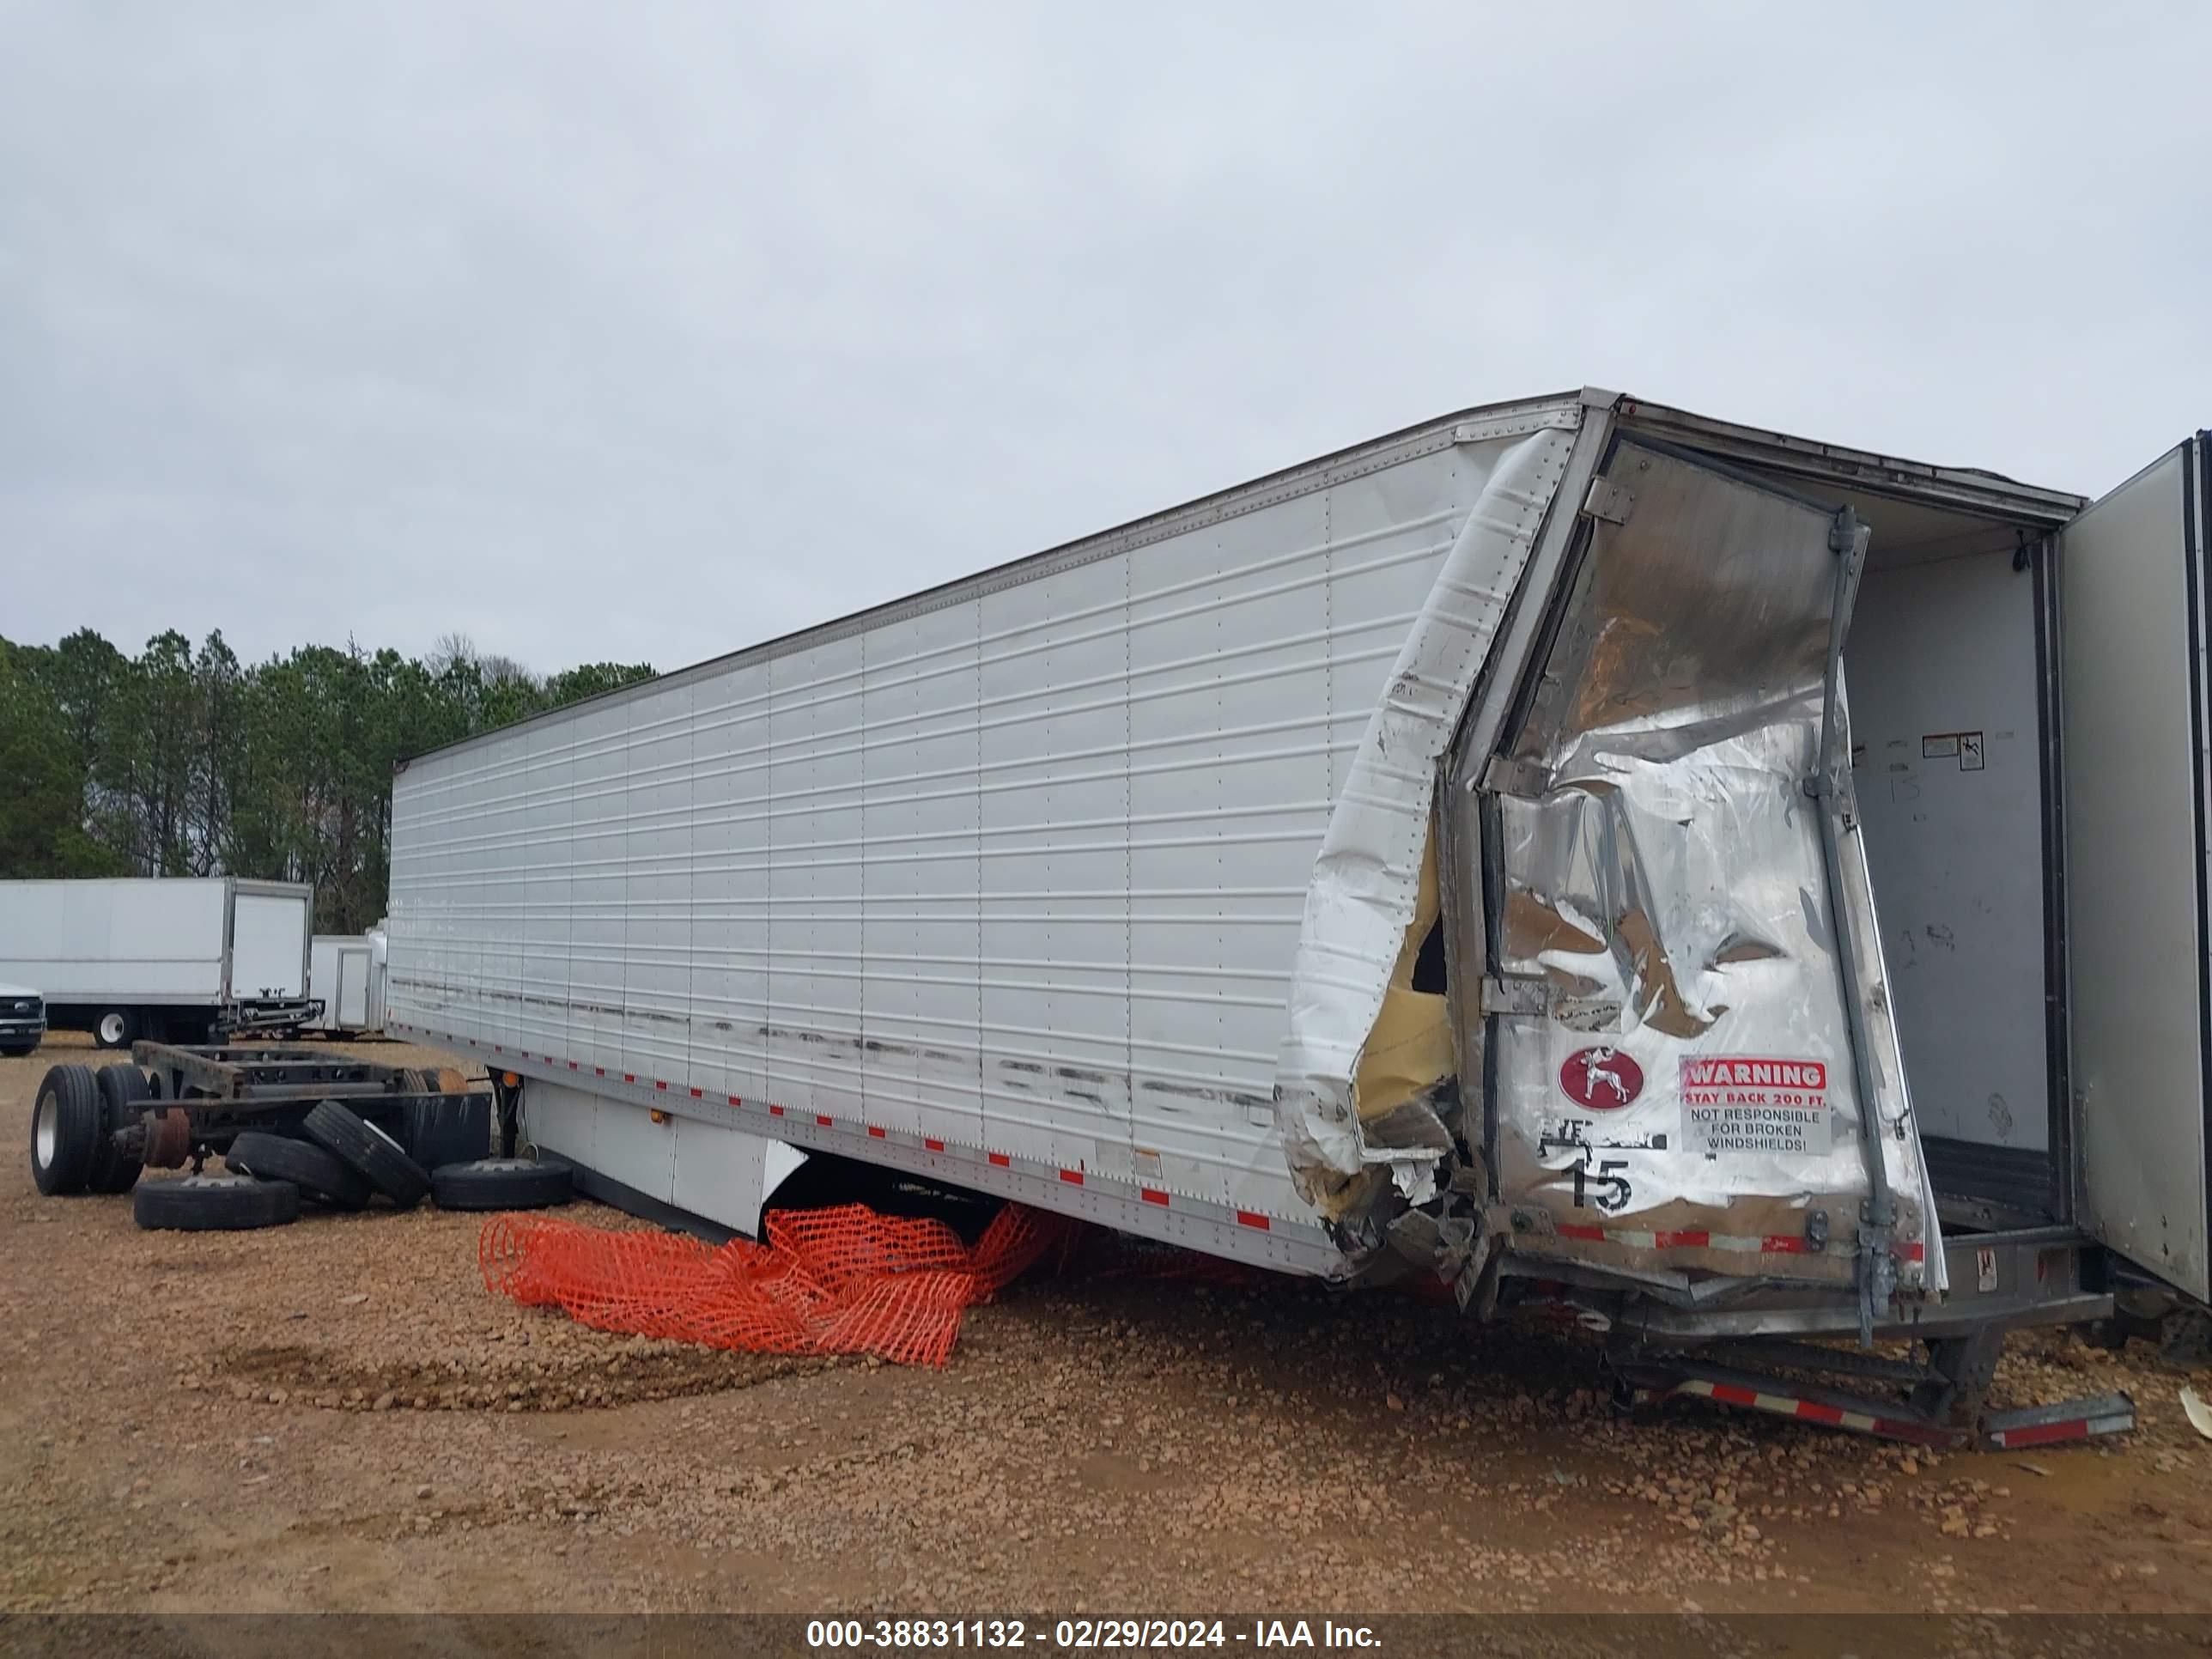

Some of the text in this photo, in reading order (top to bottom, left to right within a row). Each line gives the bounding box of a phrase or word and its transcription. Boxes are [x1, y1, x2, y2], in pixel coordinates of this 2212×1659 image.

[1690, 1063, 1821, 1087] WARNING
[1685, 1091, 1826, 1107] STAY BACK 200 FT.
[1691, 1108, 1820, 1123] NOT RESPONSIBLE
[1711, 1122, 1802, 1136] FOR BROKEN
[1708, 1137, 1806, 1152] WINDSHIELDS!
[1561, 1159, 1632, 1211] 15
